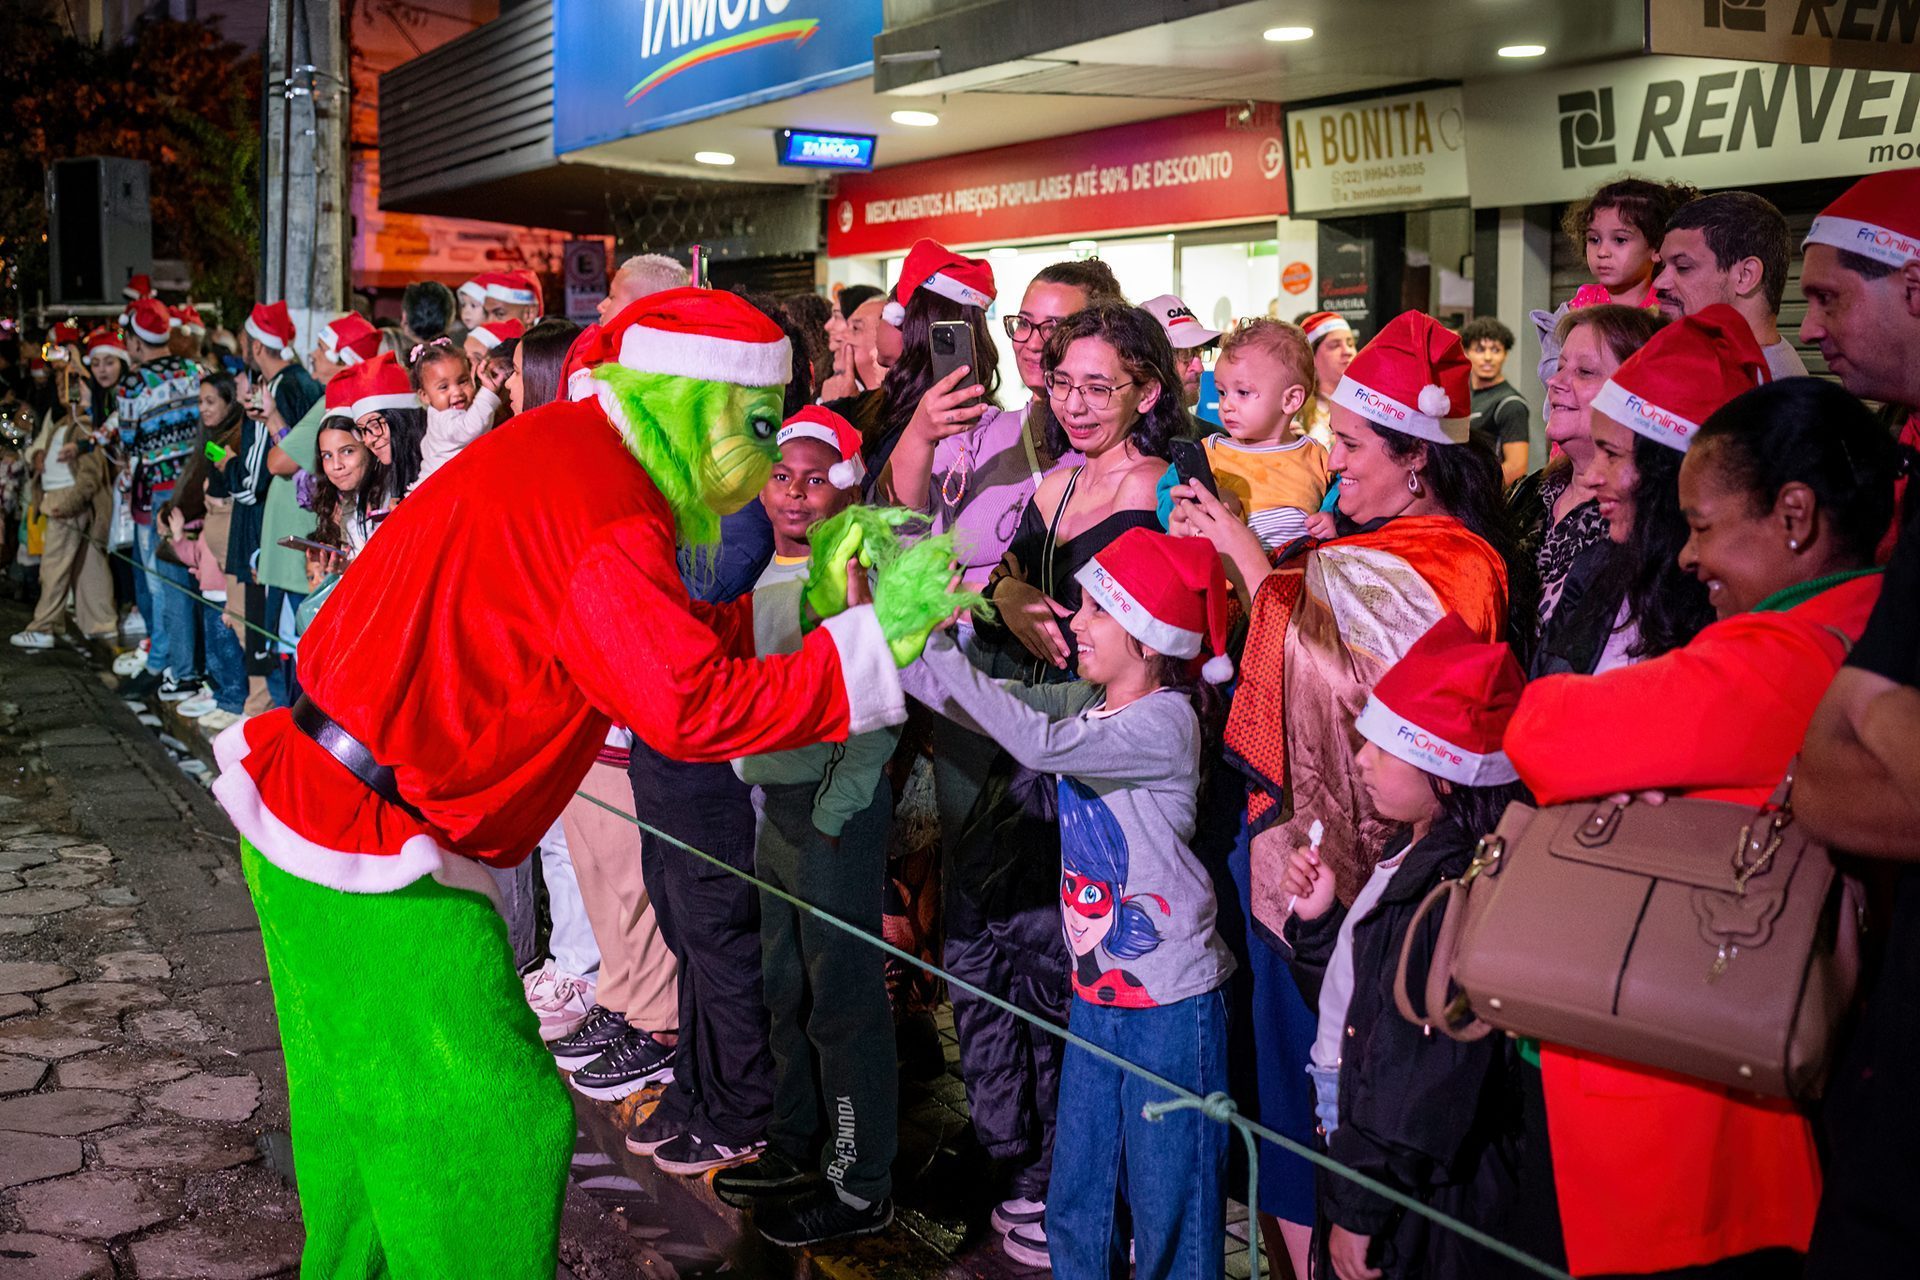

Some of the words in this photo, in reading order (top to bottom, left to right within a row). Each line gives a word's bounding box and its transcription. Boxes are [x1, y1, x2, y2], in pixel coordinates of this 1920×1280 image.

[640, 0, 792, 58] TAMO
[1295, 120, 1311, 170] A
[1320, 101, 1434, 167] BONITA
[1868, 142, 1920, 163] mo
[865, 192, 944, 224] MEDICAMENTOS
[944, 193, 954, 214] A
[954, 184, 998, 217] PREÇOS
[1000, 173, 1072, 207] POPULARES
[1073, 164, 1097, 198] ATÉ
[1100, 165, 1129, 195] 90%
[1132, 162, 1151, 190] DE
[1154, 150, 1233, 187] DESCONTO
[1355, 388, 1406, 421] FriOnline
[1626, 395, 1688, 436] FriOnline
[1093, 567, 1132, 613] FriOnline
[1397, 725, 1463, 766] FriOnline
